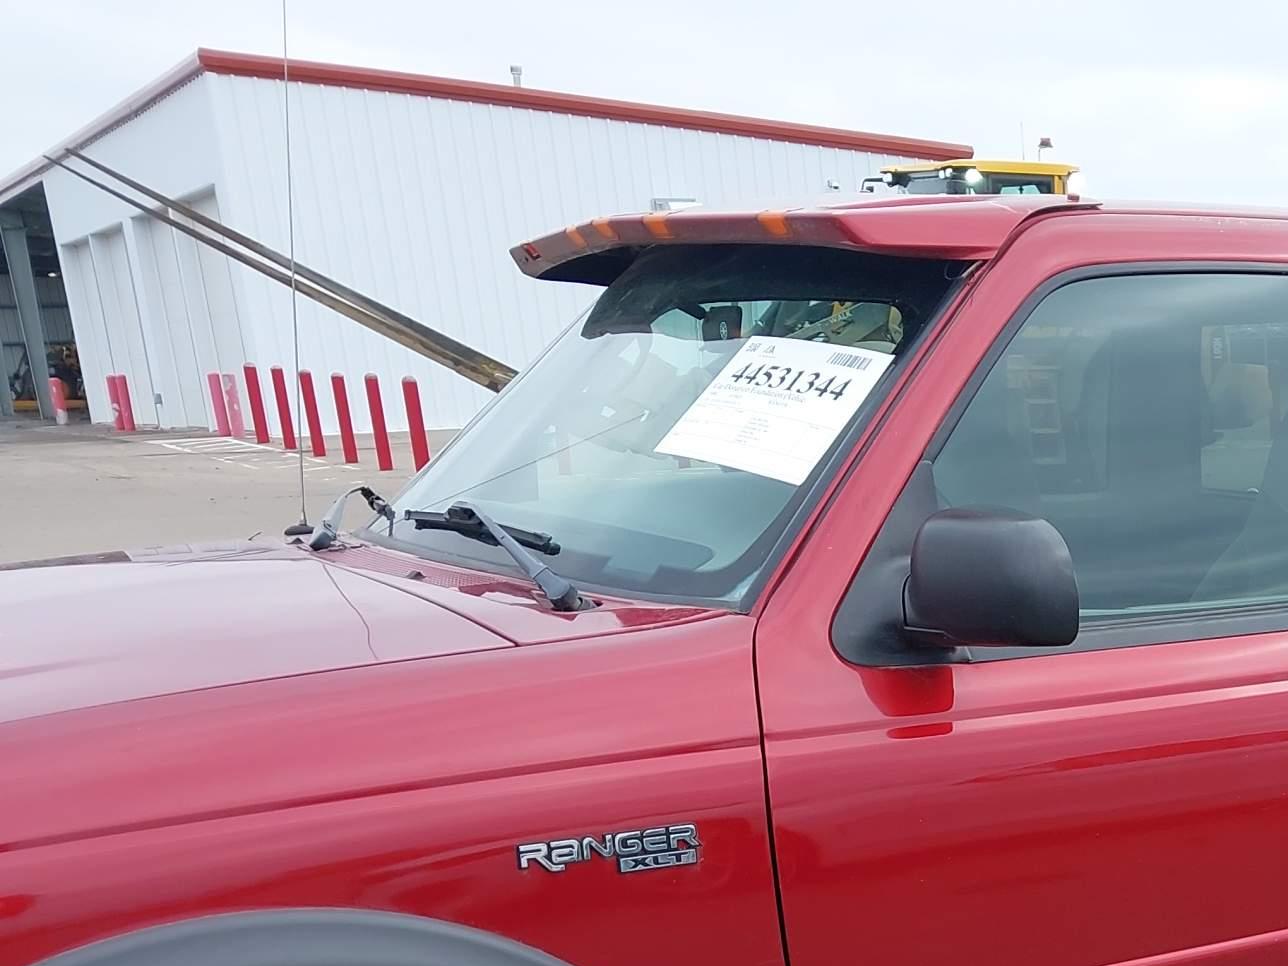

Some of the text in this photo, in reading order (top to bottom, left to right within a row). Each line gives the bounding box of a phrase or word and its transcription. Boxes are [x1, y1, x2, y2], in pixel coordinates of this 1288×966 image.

[731, 361, 853, 401] 44531344
[518, 823, 703, 873] RANGER
[630, 851, 690, 869] XLT
